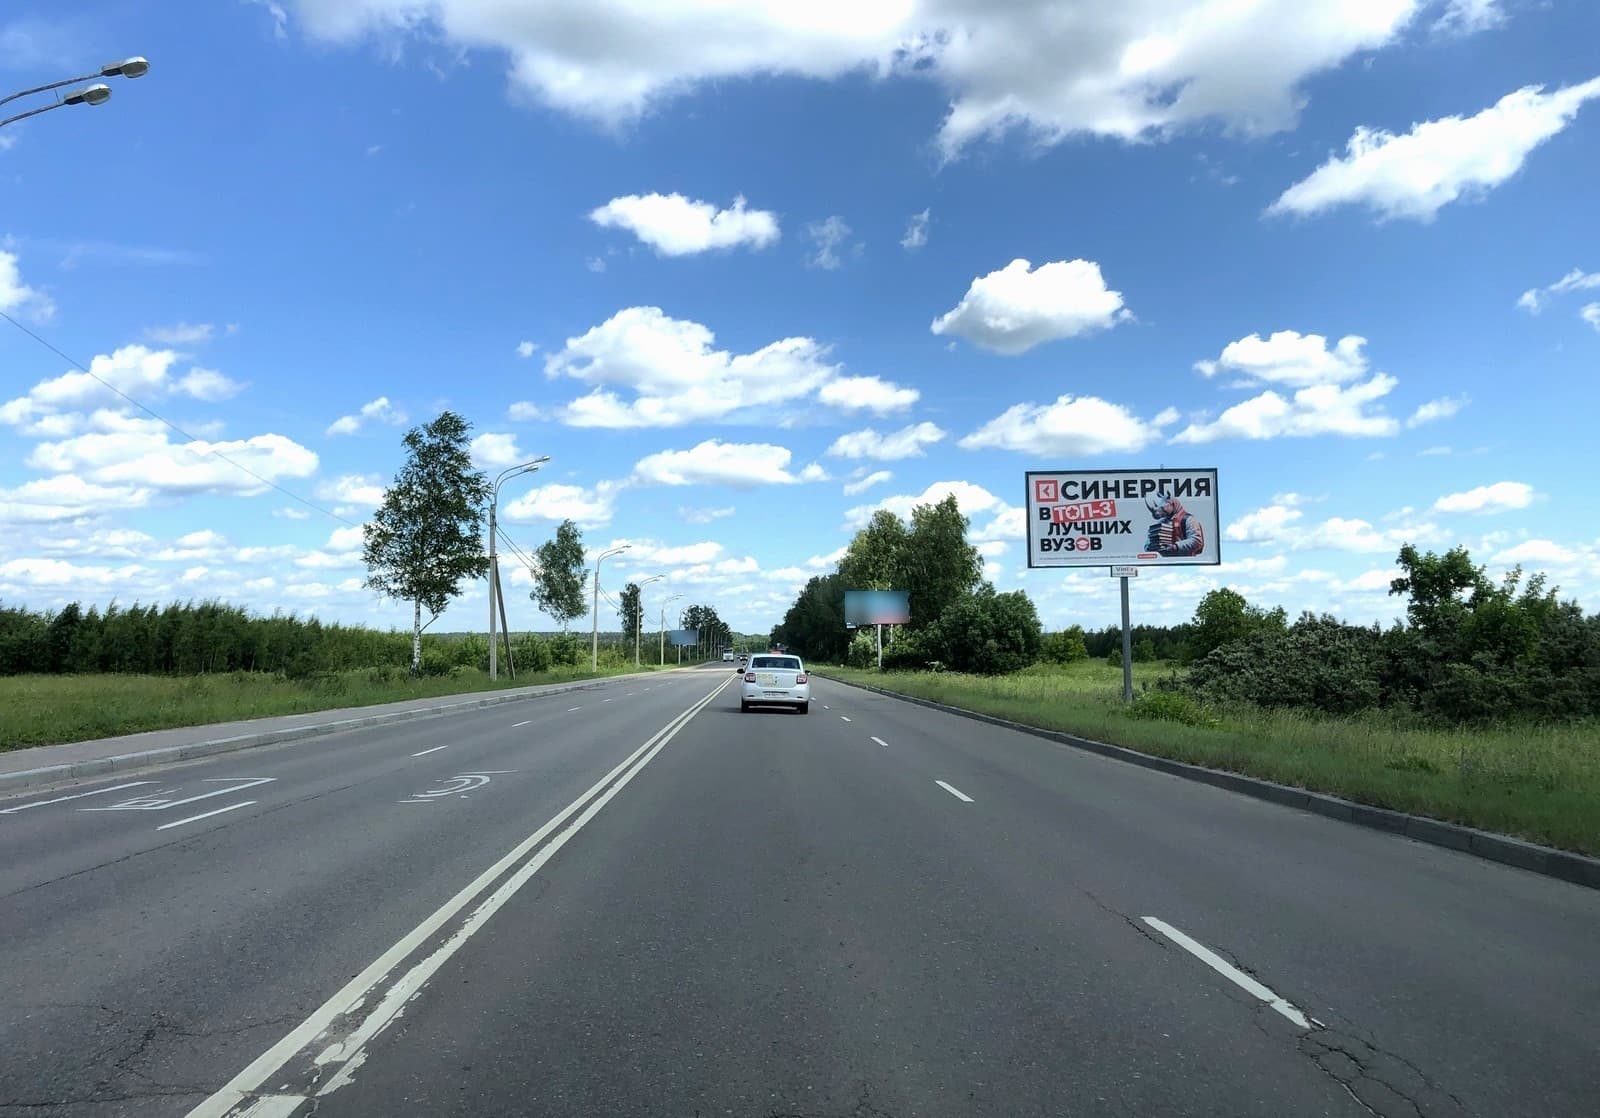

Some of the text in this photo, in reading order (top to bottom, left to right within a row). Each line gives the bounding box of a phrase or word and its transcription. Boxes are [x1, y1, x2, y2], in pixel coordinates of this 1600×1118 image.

[1061, 478, 1210, 500] СИНЕРГИЯ
[1039, 507, 1051, 520] В
[1048, 520, 1132, 535] ЛУЧШИХ
[1040, 537, 1102, 552] ВУЗОВ
